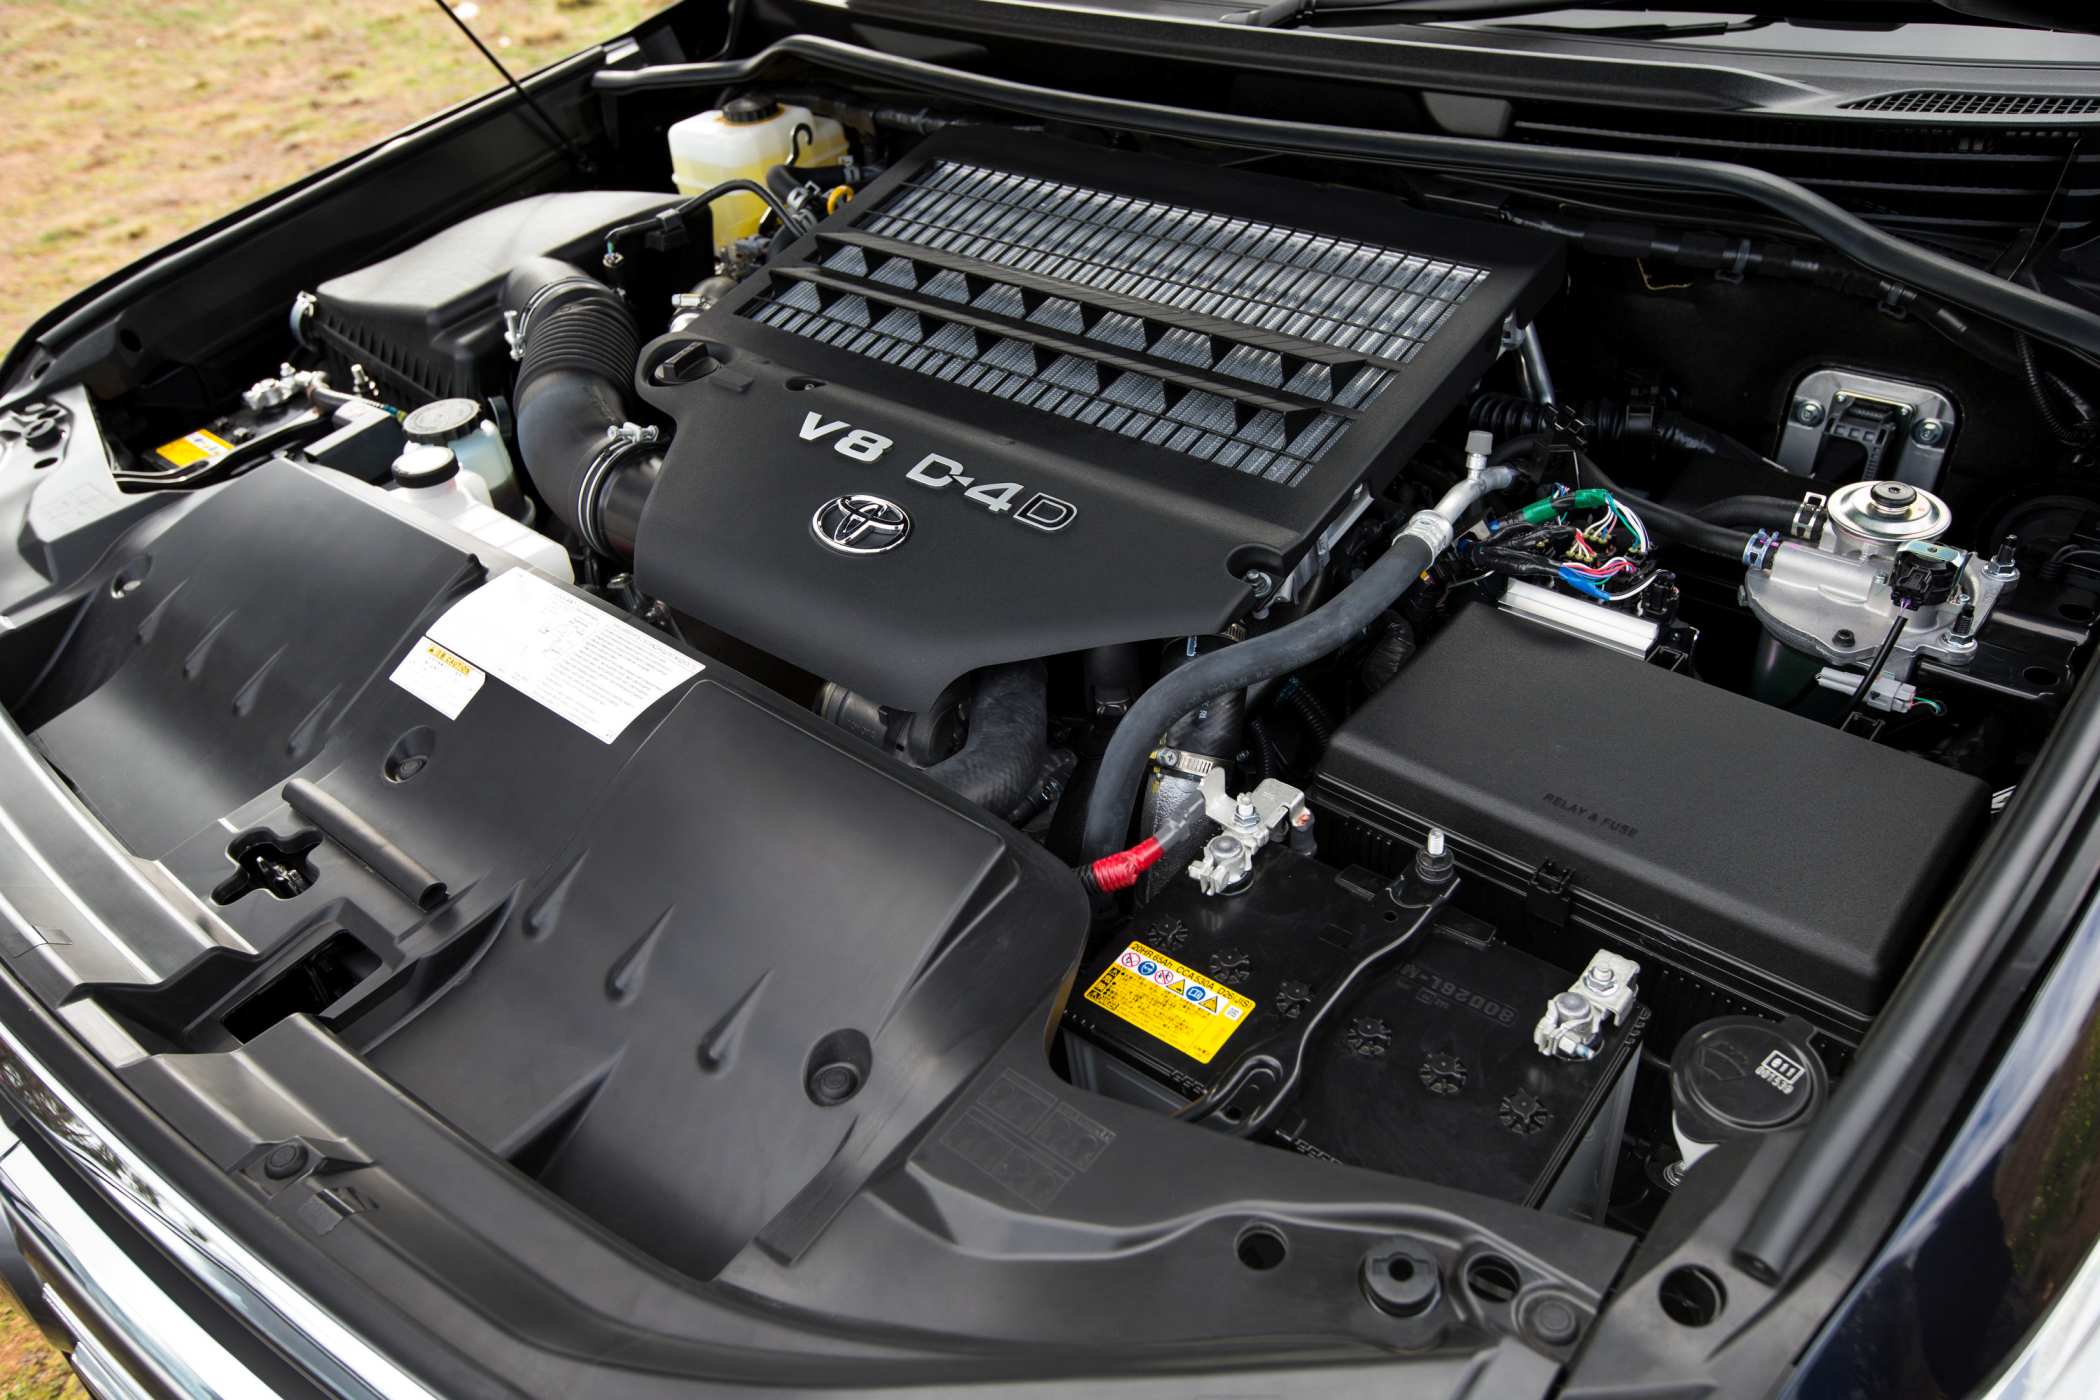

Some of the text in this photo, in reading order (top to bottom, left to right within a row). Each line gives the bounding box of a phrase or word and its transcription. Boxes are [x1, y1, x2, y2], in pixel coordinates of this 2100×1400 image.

[799, 411, 894, 464] V8
[1542, 792, 1639, 838] RELAY & FUSE
[1176, 966, 1194, 982] CCA
